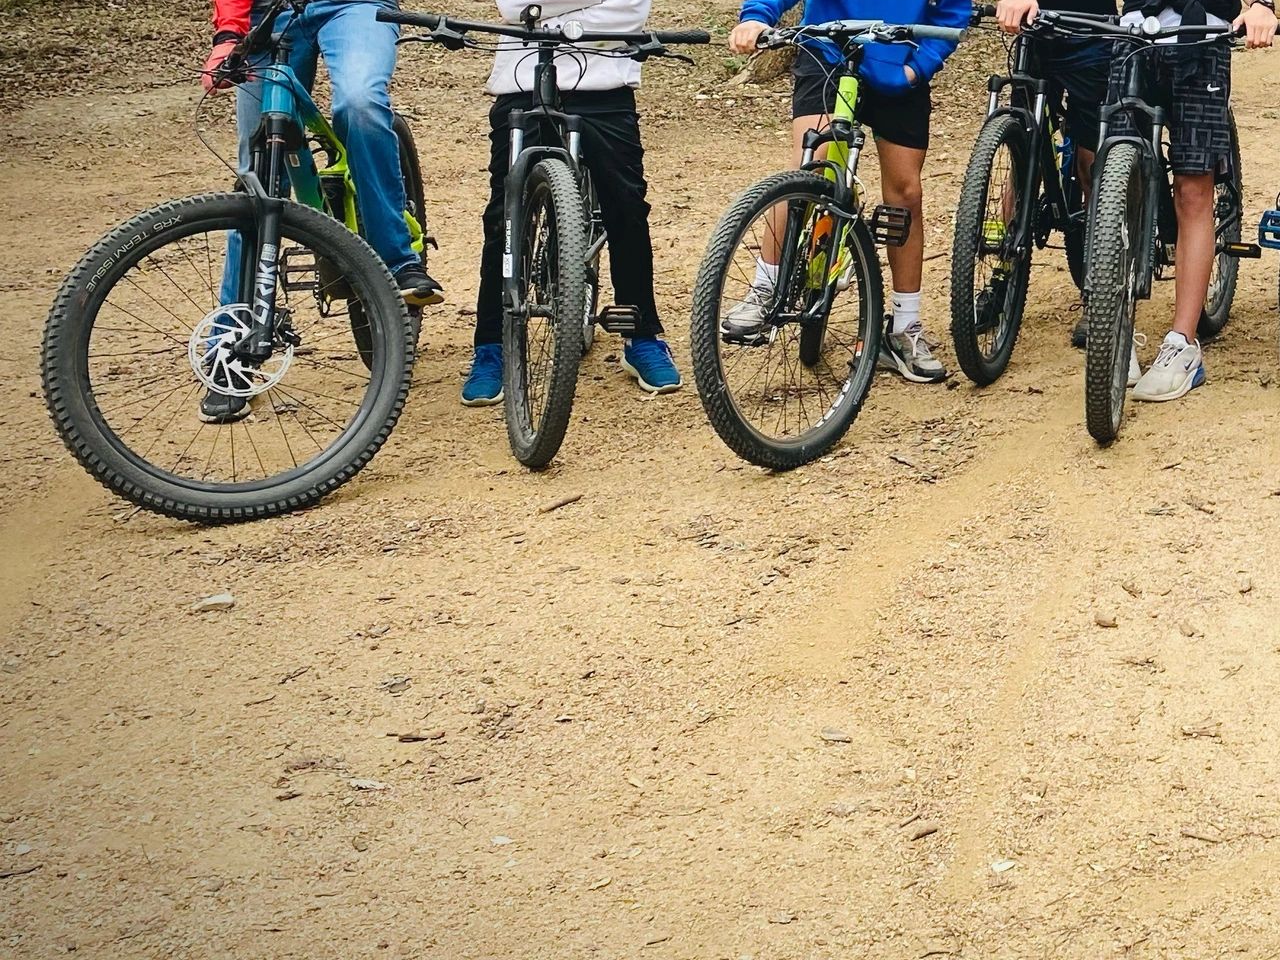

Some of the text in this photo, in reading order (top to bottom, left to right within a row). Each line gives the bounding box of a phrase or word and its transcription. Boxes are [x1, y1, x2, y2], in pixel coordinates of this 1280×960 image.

[114, 231, 150, 259] TEAM
[86, 256, 115, 293] ISSUE
[253, 260, 277, 326] LYRIK
